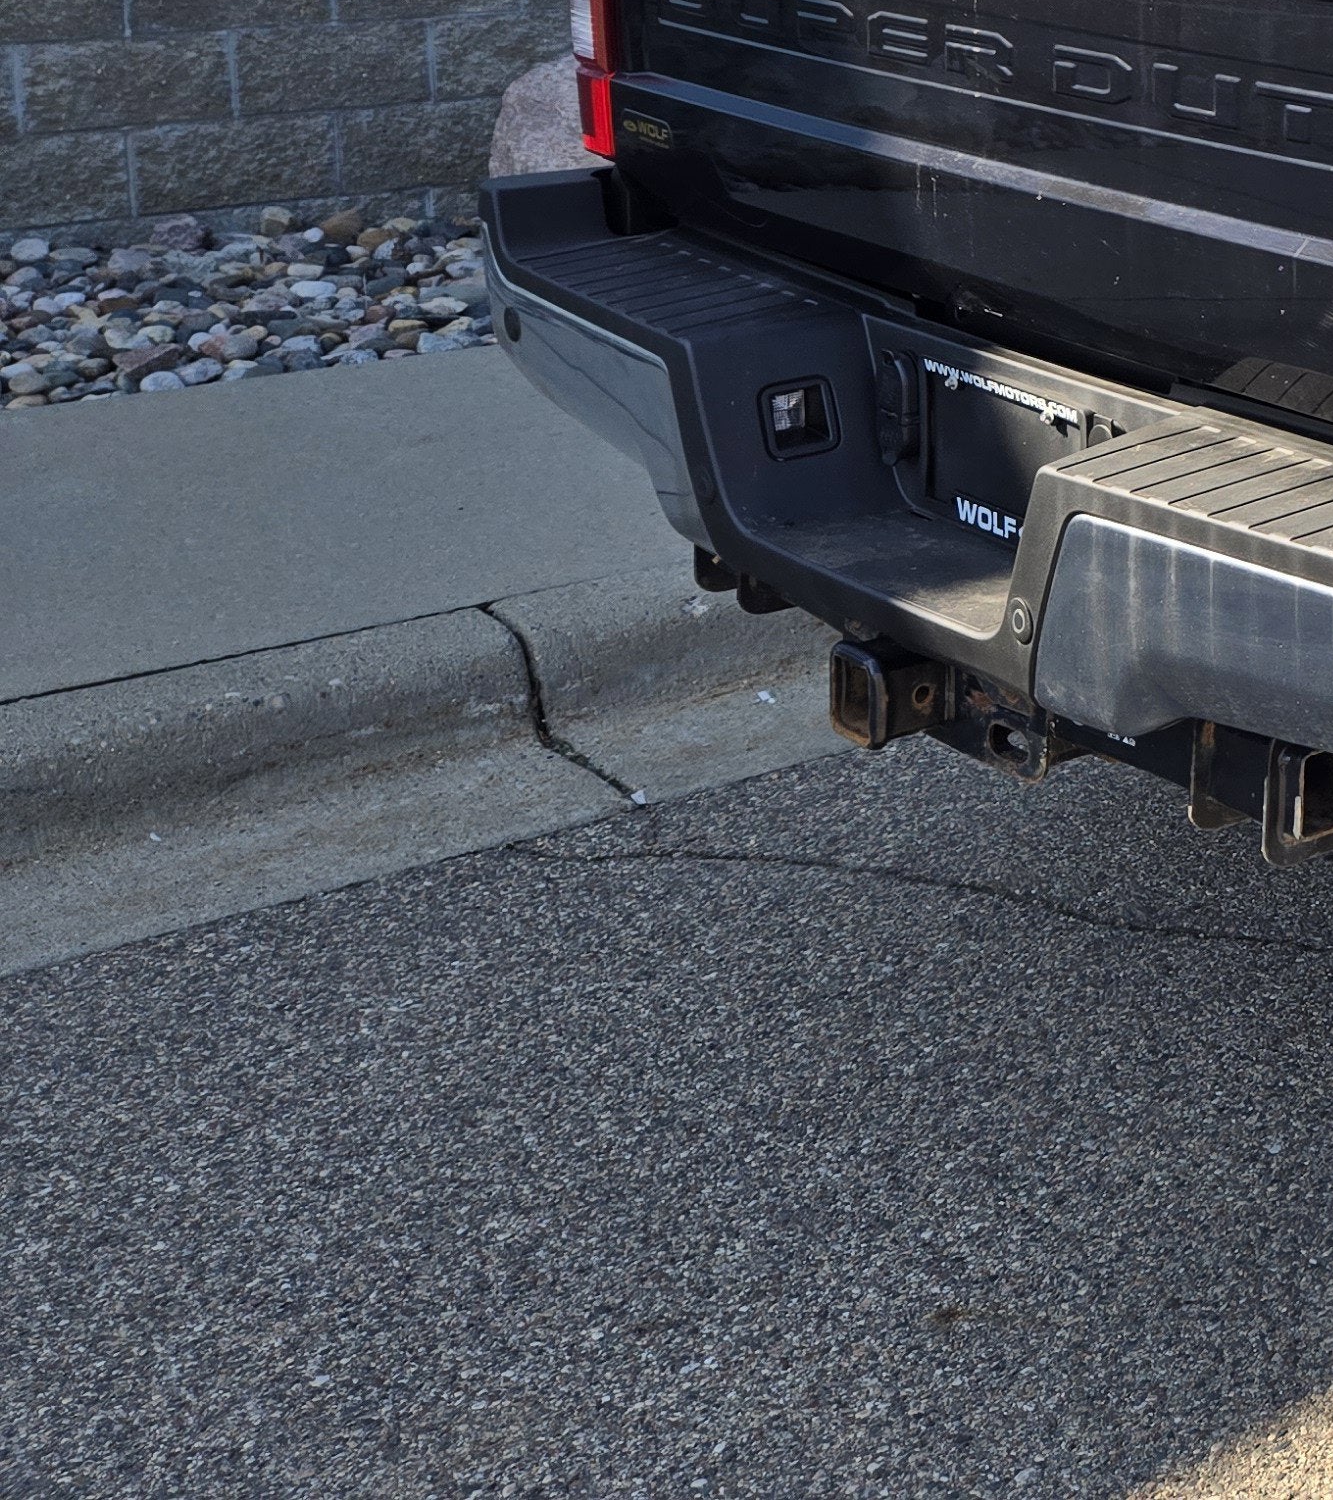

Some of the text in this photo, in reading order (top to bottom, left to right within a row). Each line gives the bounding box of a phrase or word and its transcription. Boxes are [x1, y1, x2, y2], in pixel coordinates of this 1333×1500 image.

[636, 119, 669, 141] WOLF
[923, 358, 1078, 424] WWW.WOLFMOTORSCOM
[956, 496, 1017, 539] WOLF
